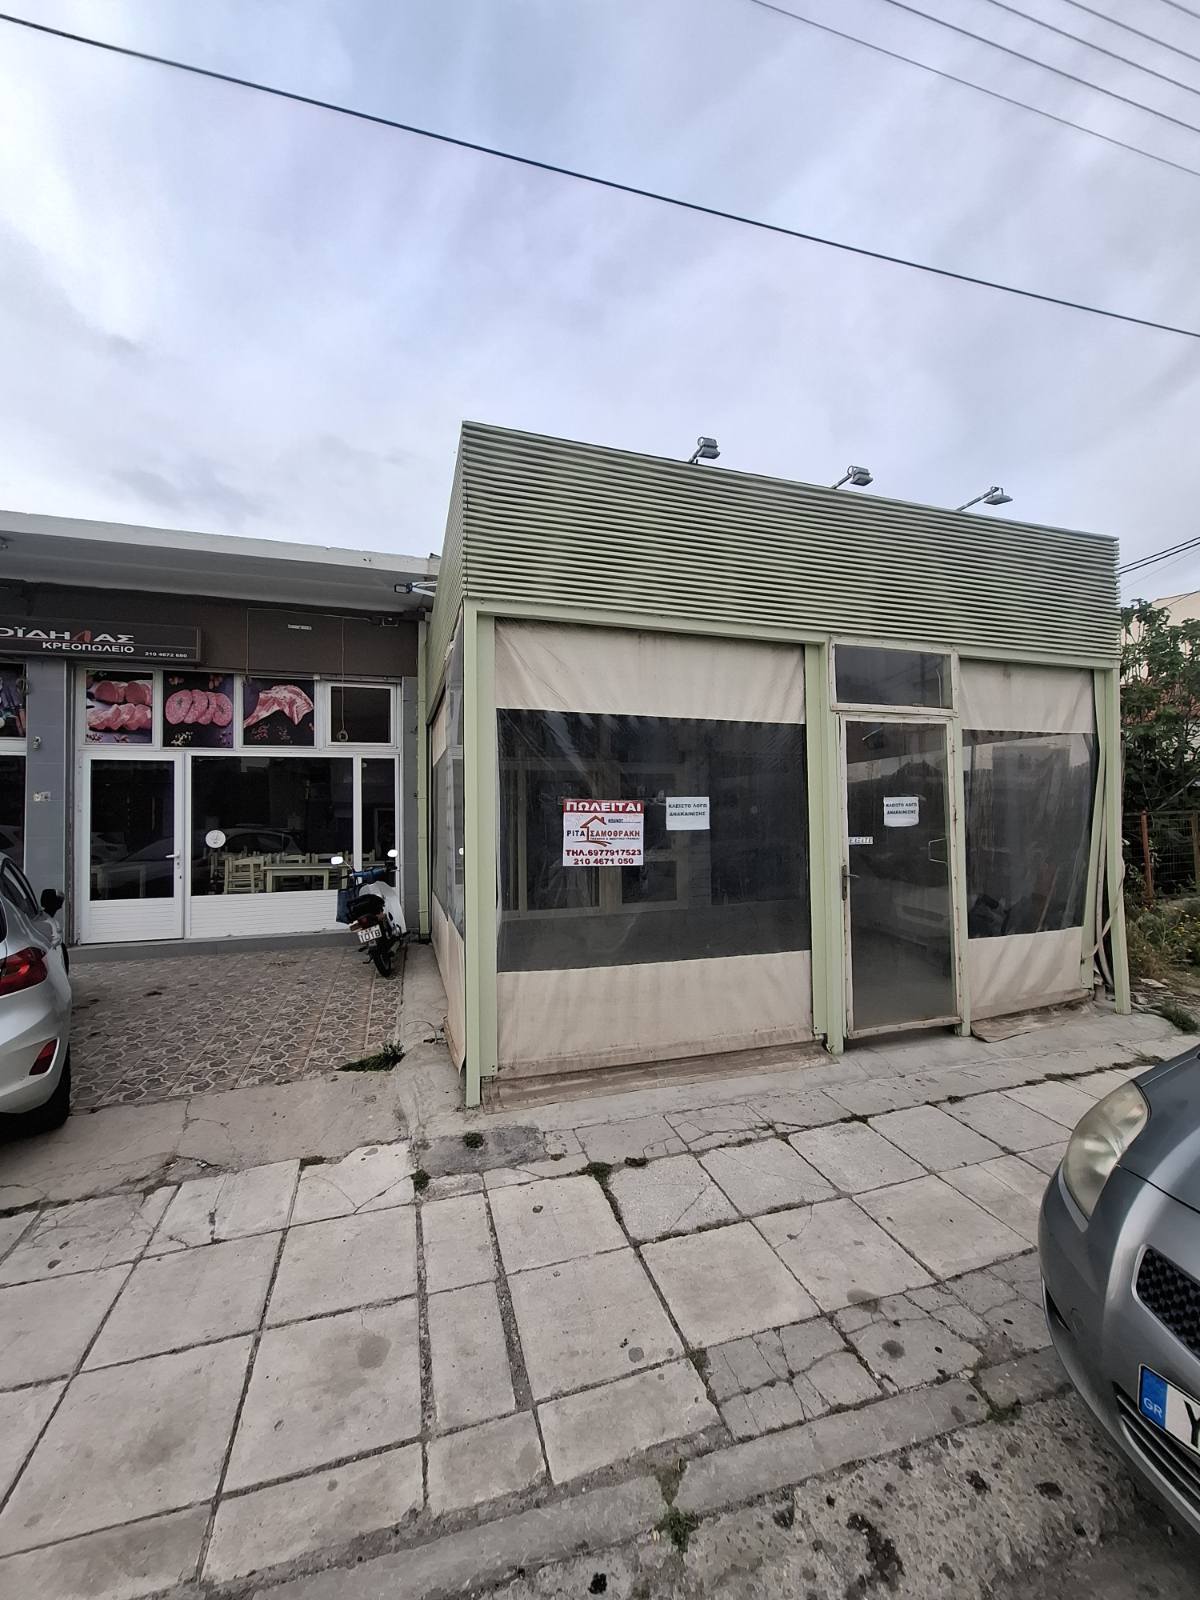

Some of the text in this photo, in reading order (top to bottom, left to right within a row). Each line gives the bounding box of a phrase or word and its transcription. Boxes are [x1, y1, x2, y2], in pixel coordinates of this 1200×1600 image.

[42, 641, 135, 653] ΚΡΕΟΠΩΛΕΙΟ
[566, 802, 642, 812] ΠΩΛΕΙΤΑΙ
[617, 857, 634, 865] 050
[1143, 1398, 1200, 1449] GR Y
